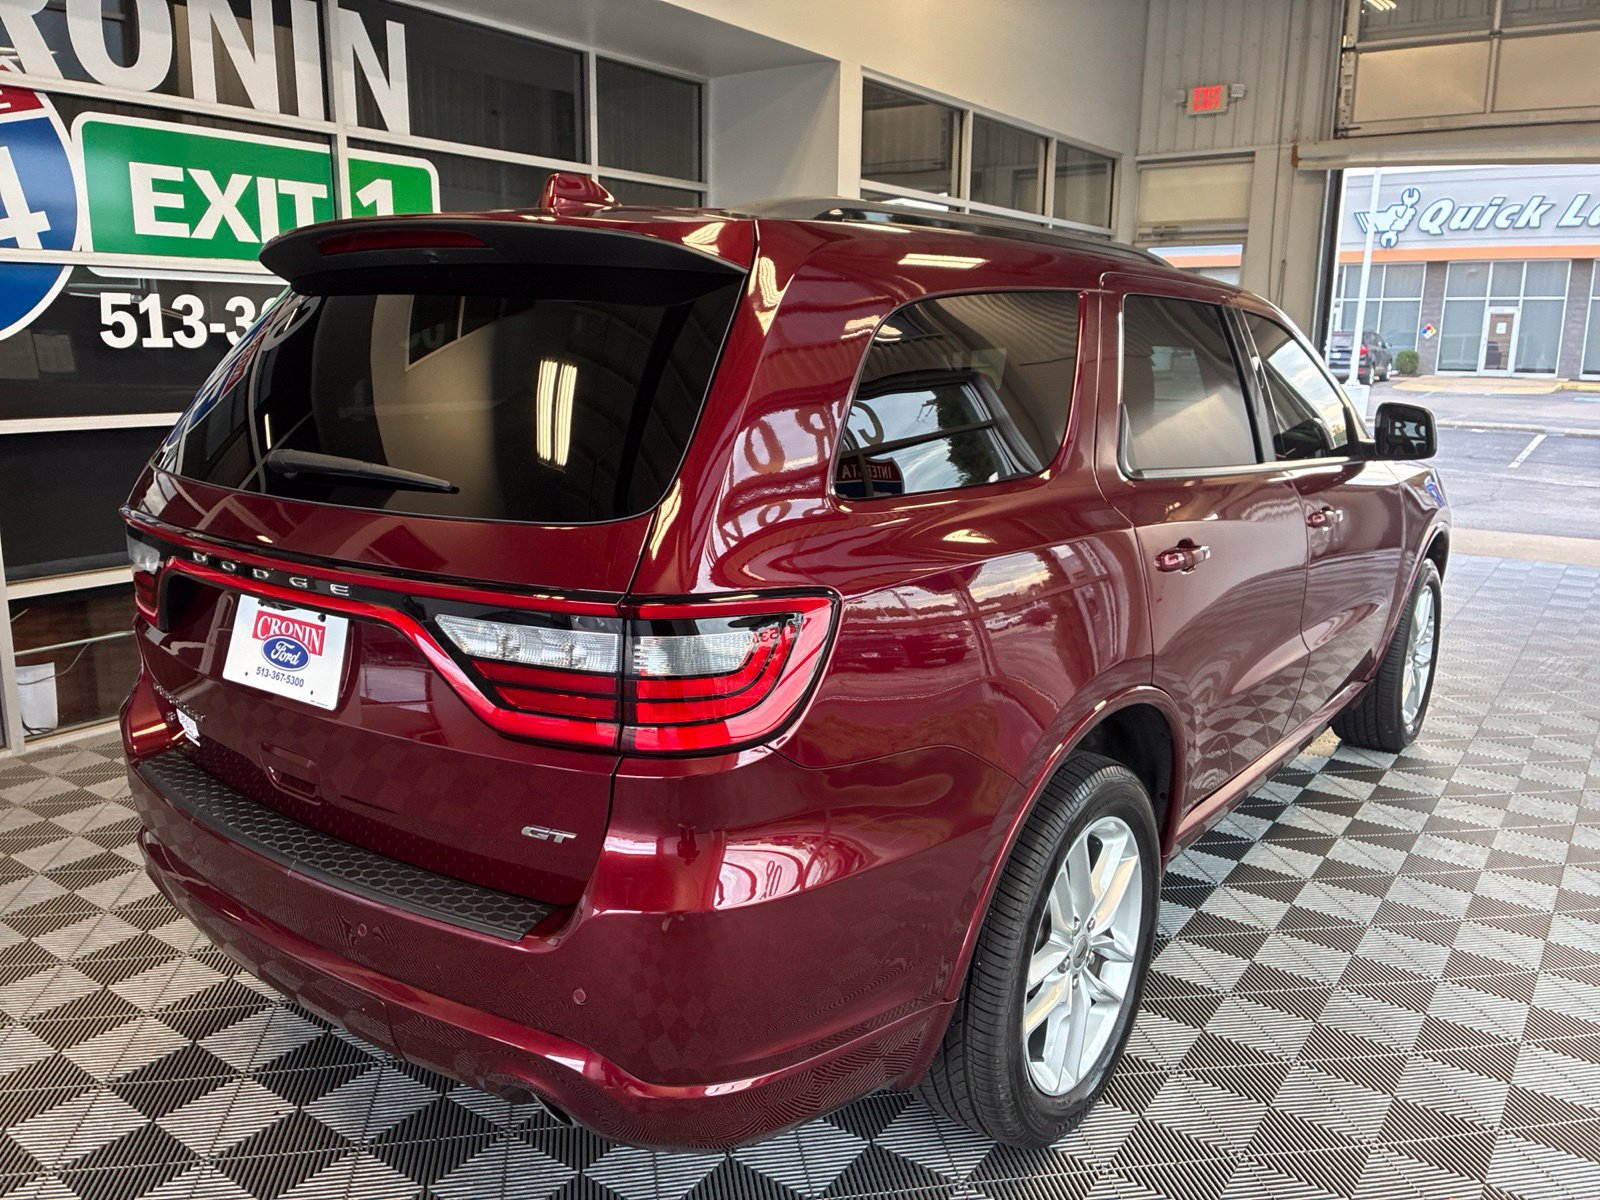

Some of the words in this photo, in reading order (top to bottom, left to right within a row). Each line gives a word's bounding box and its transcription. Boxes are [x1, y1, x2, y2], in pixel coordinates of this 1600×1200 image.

[1193, 85, 1223, 111] EXIT
[129, 161, 328, 243] EXIT
[356, 178, 394, 215] 1
[1418, 195, 1556, 236] Quick
[192, 551, 350, 597] DODGE
[256, 615, 323, 655] CRONIN
[270, 641, 301, 666] Ford
[255, 666, 305, 688] 513-367-5300
[521, 825, 578, 844] GT
